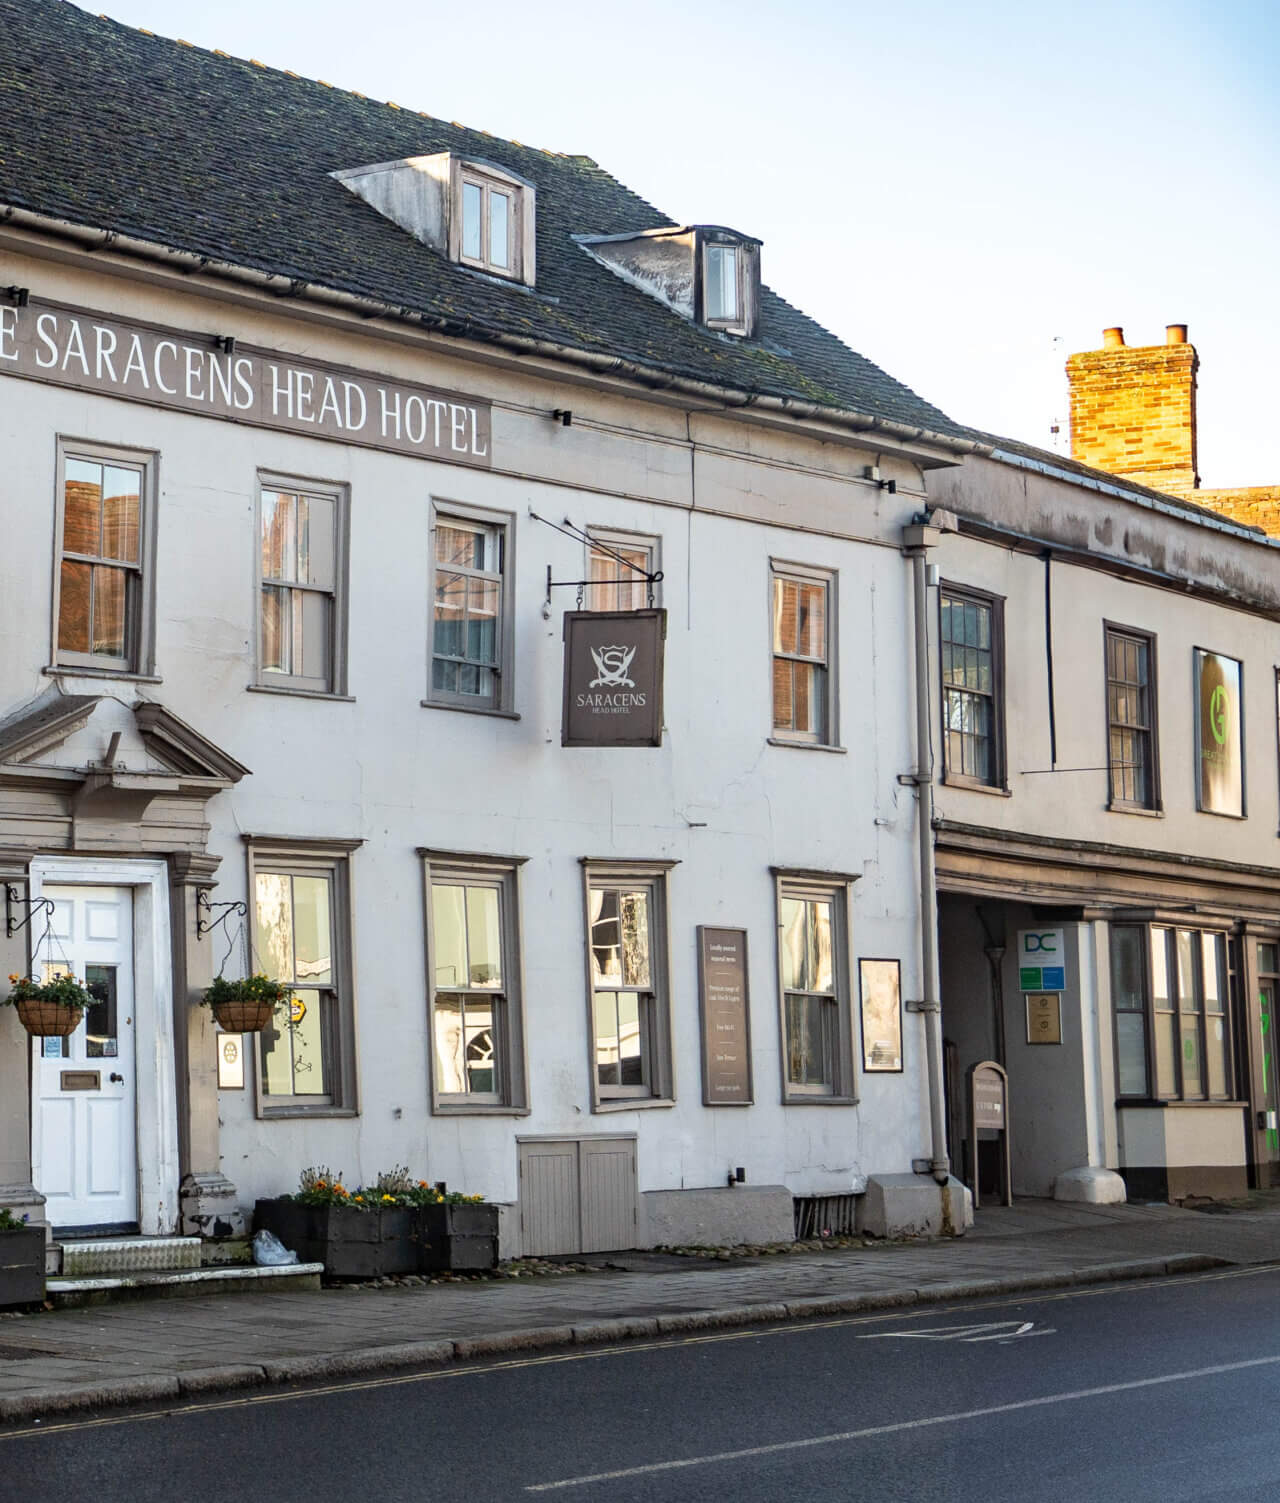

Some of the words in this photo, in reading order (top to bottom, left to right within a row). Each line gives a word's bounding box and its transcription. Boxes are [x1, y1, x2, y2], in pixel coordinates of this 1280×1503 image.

[35, 313, 254, 410] SARACENS
[269, 364, 368, 432] HEAD
[377, 388, 487, 457] HOTEL
[577, 692, 647, 707] SARACENS
[1024, 933, 1057, 952] DC
